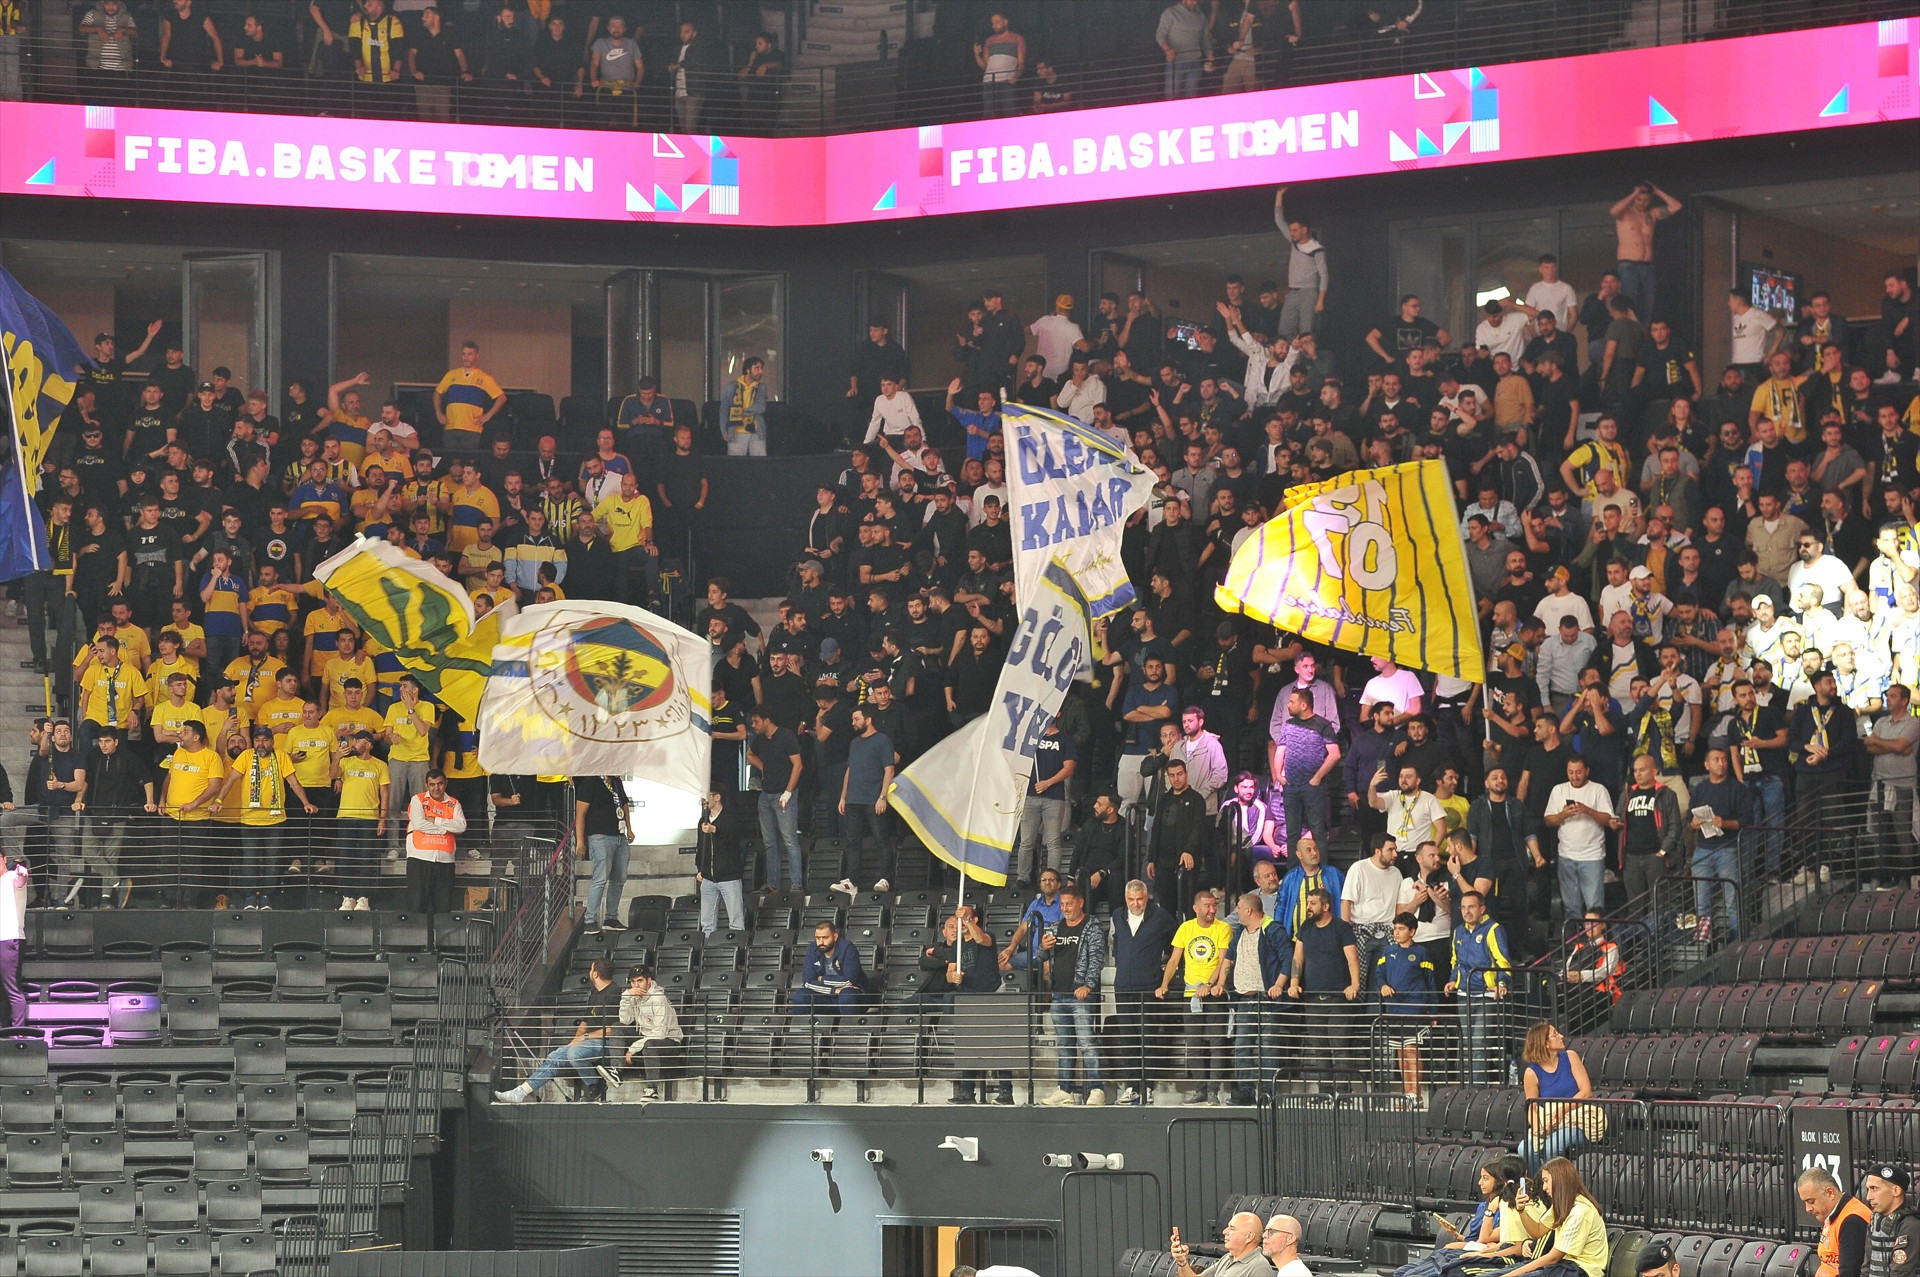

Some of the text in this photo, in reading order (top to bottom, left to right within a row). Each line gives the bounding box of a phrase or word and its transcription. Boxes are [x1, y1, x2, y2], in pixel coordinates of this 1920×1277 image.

[1628, 795, 1655, 812] UCLA
[1801, 1131, 1841, 1143] BLOK BLOCK
